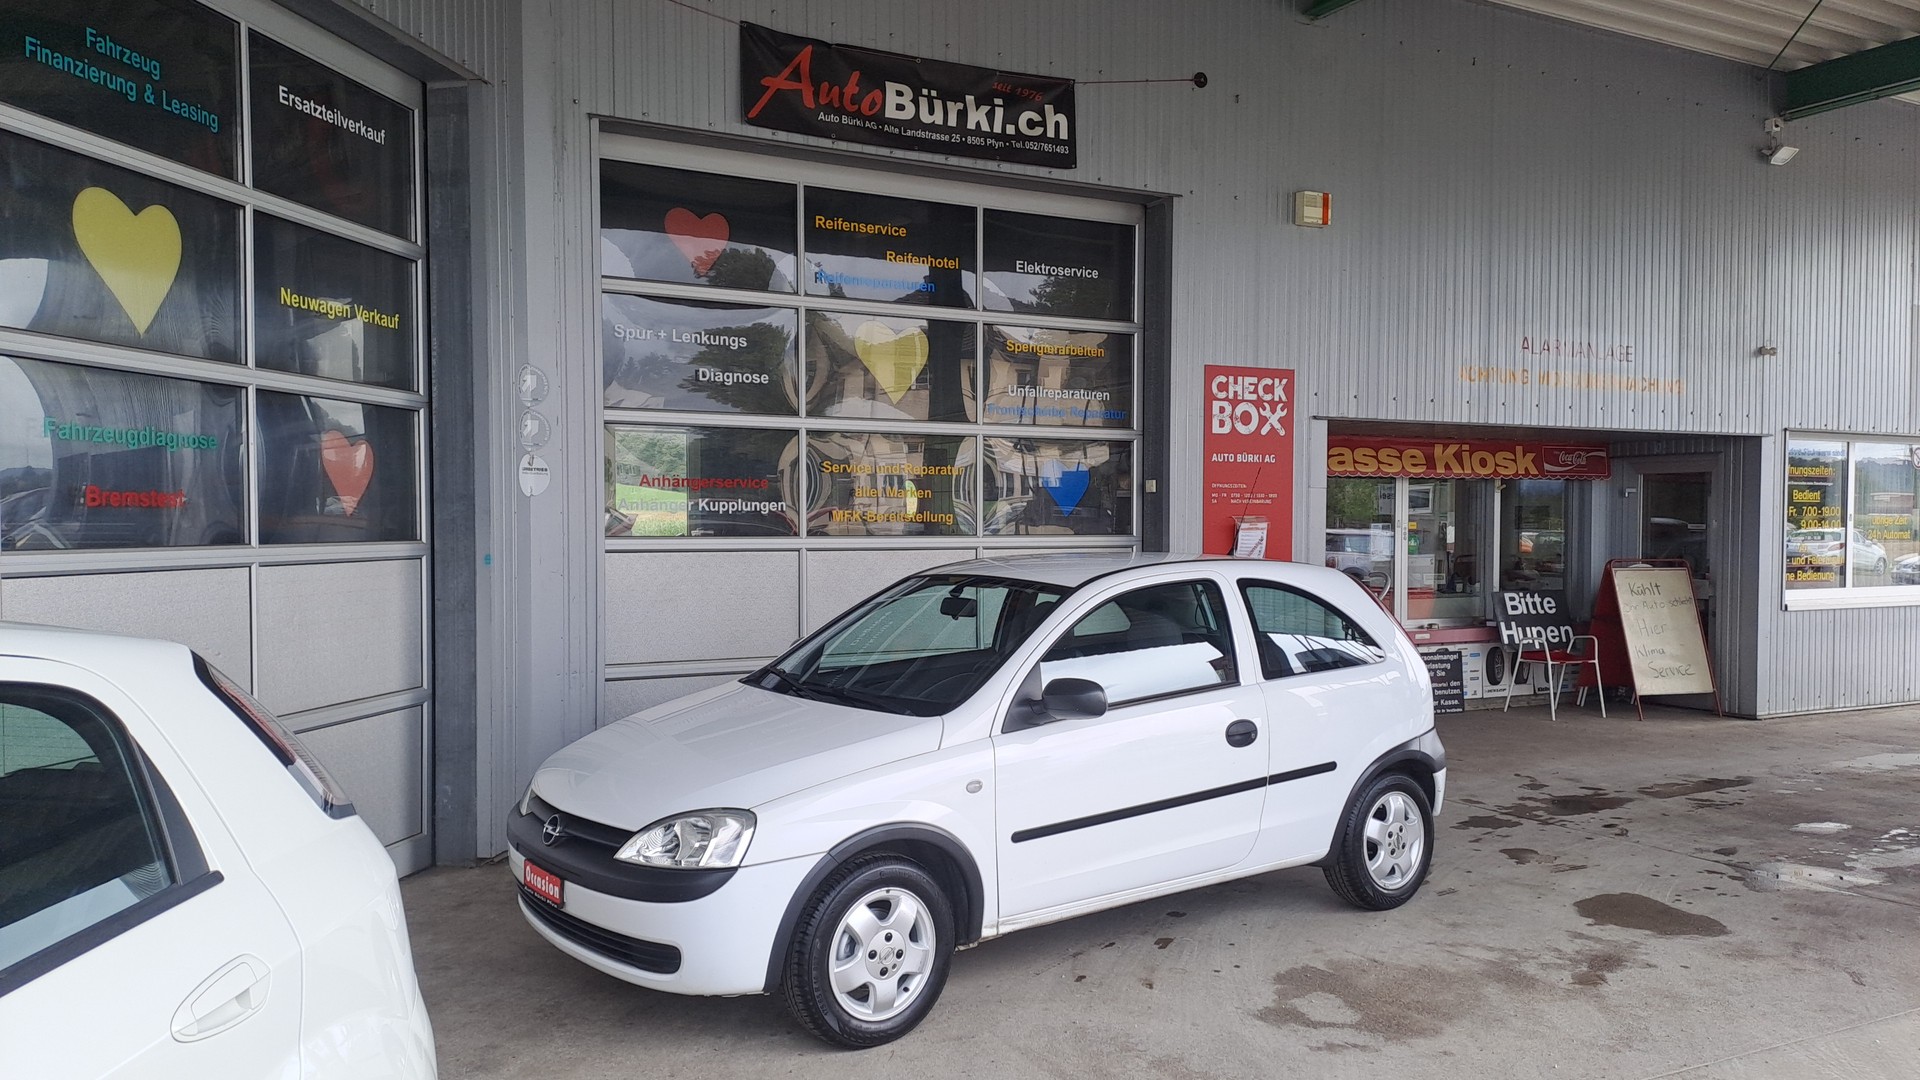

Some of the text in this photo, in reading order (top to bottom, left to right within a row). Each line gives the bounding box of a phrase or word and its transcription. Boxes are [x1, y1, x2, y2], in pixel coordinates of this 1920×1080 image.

[86, 27, 161, 80] Fahrzeug
[25, 36, 220, 134] Finanzierung & Leasing
[992, 81, 1044, 102] seit 1976
[279, 85, 386, 145] Ersatzteilverkauf
[818, 111, 838, 123] Auto
[839, 114, 863, 127] Bürki
[865, 119, 878, 130] AG
[883, 123, 899, 135] Alte
[901, 126, 950, 142] Landstrasse
[951, 133, 961, 144] 25
[967, 135, 985, 147] 8505
[986, 137, 1005, 149] Pfyn
[815, 215, 907, 237] Reifenservice
[886, 250, 959, 270] Reifenhotel
[1016, 260, 1099, 279] Elektroservice
[280, 287, 401, 330] Neuwagen Verkauf
[614, 324, 652, 341] Spur
[672, 328, 748, 350] Lenkungs
[1006, 339, 1105, 358] Spenglerarbeiten
[698, 367, 769, 385] Diagnose
[1008, 384, 1110, 401] Unfallreparaturen
[1211, 375, 1288, 402] CHECK
[1212, 400, 1288, 436] BOX
[43, 417, 218, 453] Fahrzeugdiagnose
[1212, 452, 1276, 464] AUTO BÜRKI AG
[1328, 443, 1540, 476] asse Kiosk
[823, 460, 964, 478] Service und Reparatur
[640, 474, 769, 491] Anhängerservice
[855, 485, 932, 500] aller Marken
[85, 486, 186, 509] Bremstest
[1793, 489, 1821, 500] Bedient
[619, 497, 787, 515] Anhänger Kupplungen
[1797, 571, 1835, 582] Bedienung
[1628, 582, 1661, 596] Kühlt
[1504, 592, 1557, 616] Bitte
[1500, 621, 1574, 649] Hupen
[1637, 619, 1667, 637] Hier
[1421, 653, 1459, 661] rsonalmangel
[1648, 660, 1696, 679] Service
[525, 865, 560, 899] Occasion
